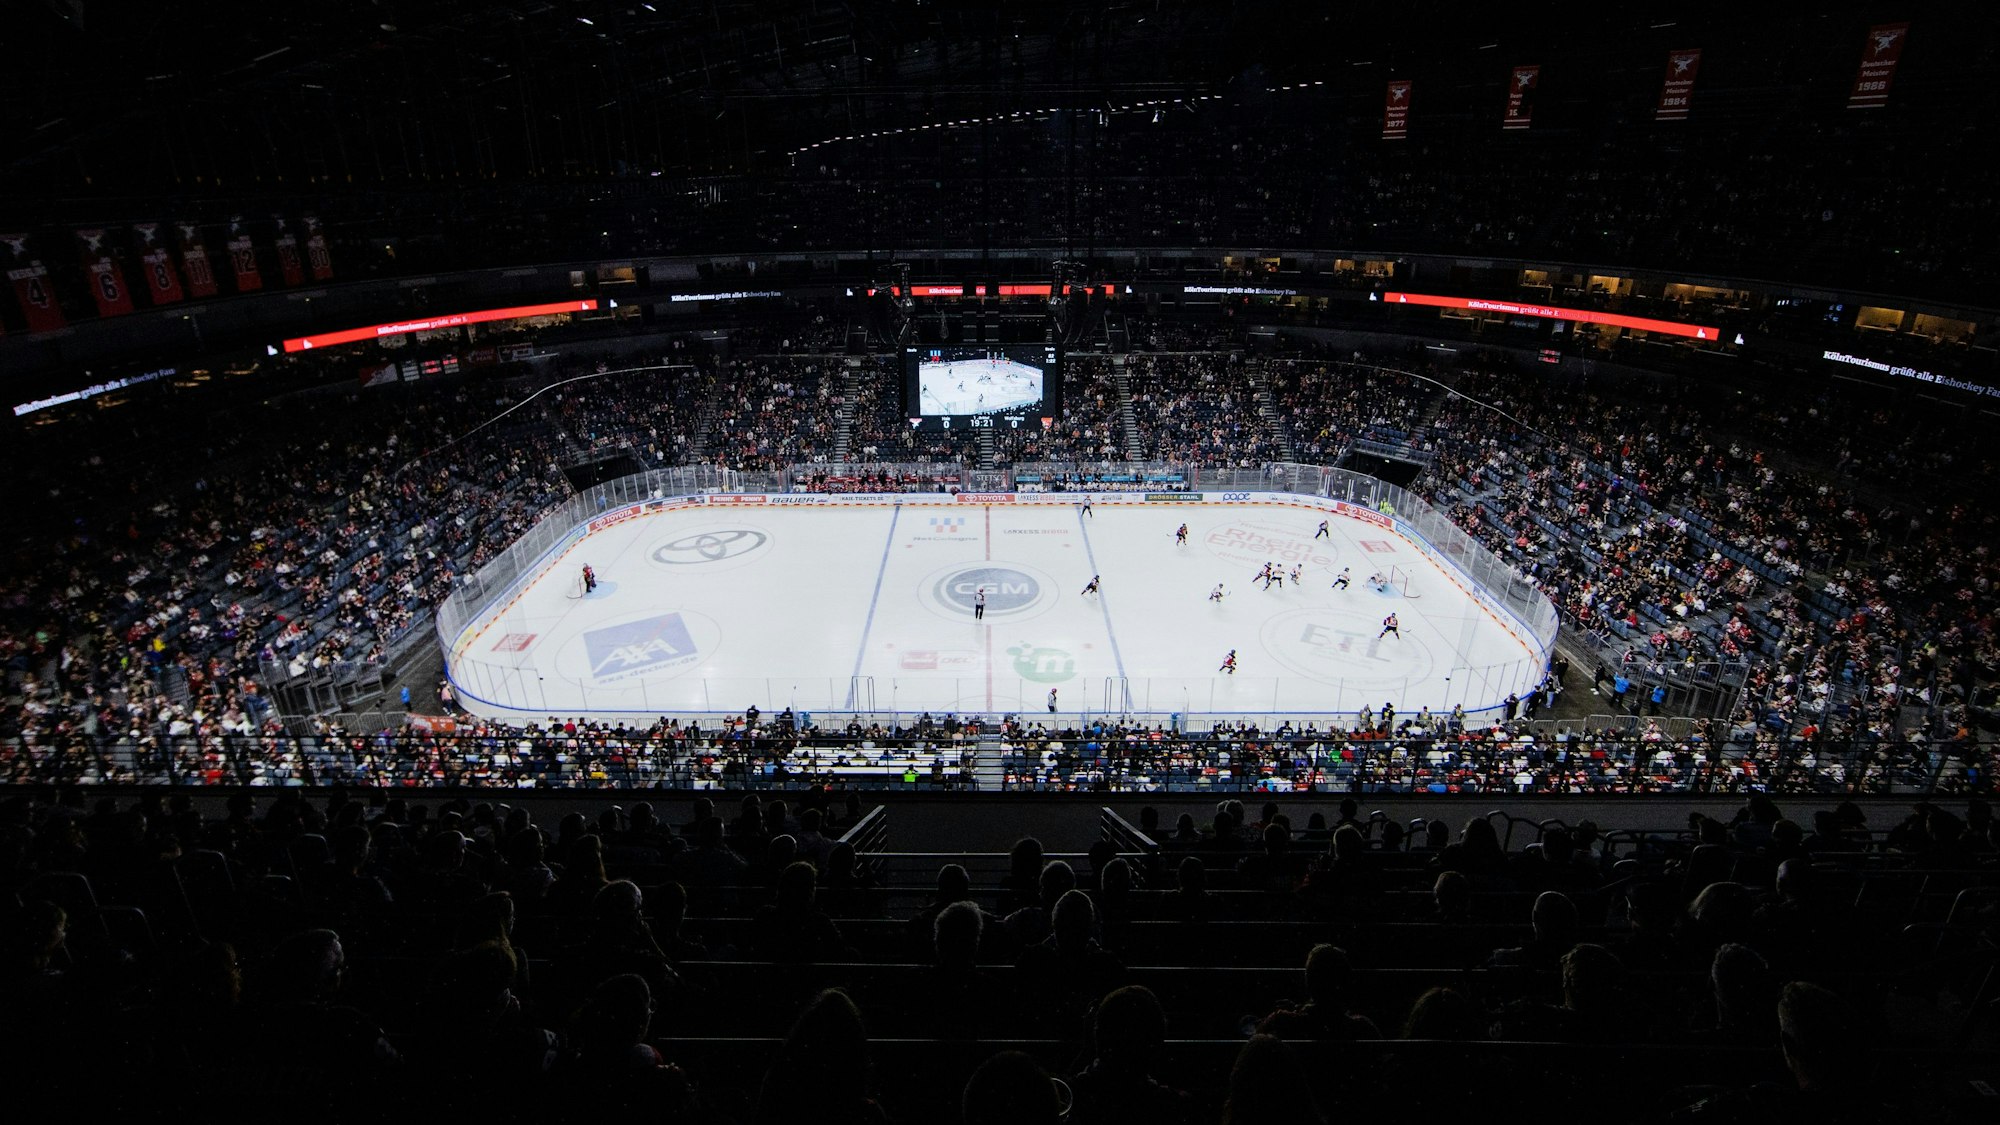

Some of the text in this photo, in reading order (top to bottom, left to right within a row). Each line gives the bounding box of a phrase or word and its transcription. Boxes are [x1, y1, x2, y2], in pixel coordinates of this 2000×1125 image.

[1861, 69, 1890, 78] Meister
[1857, 81, 1886, 92] 1986
[1663, 97, 1687, 106] 1984
[231, 249, 258, 275] 12
[153, 263, 172, 289] 8
[28, 277, 49, 308] 4
[97, 272, 118, 302] 6
[1184, 286, 1227, 294] KölnTourismus
[1227, 286, 1244, 295] grüßt
[671, 293, 715, 302] KölnTourismus
[1468, 301, 1519, 312] KölnTourismus
[1520, 306, 1540, 314] grüßt
[1823, 350, 1890, 372] KölnTourismus
[1890, 366, 1916, 379] grüßt
[1916, 371, 1935, 382] alle
[1934, 374, 1986, 395] Eishockey
[105, 380, 121, 391] alle
[943, 421, 950, 429] 0
[970, 419, 994, 427] 19:21
[976, 474, 1005, 482] STETSO
[1222, 493, 1251, 501] pape
[605, 509, 634, 523] TOYOTA
[1358, 507, 1385, 524] TOYOTA
[1224, 528, 1314, 553] Rhein
[1207, 533, 1332, 565] Energie
[954, 582, 1029, 595] CGM
[1299, 623, 1391, 663] ETL
[593, 638, 679, 673] AXA
